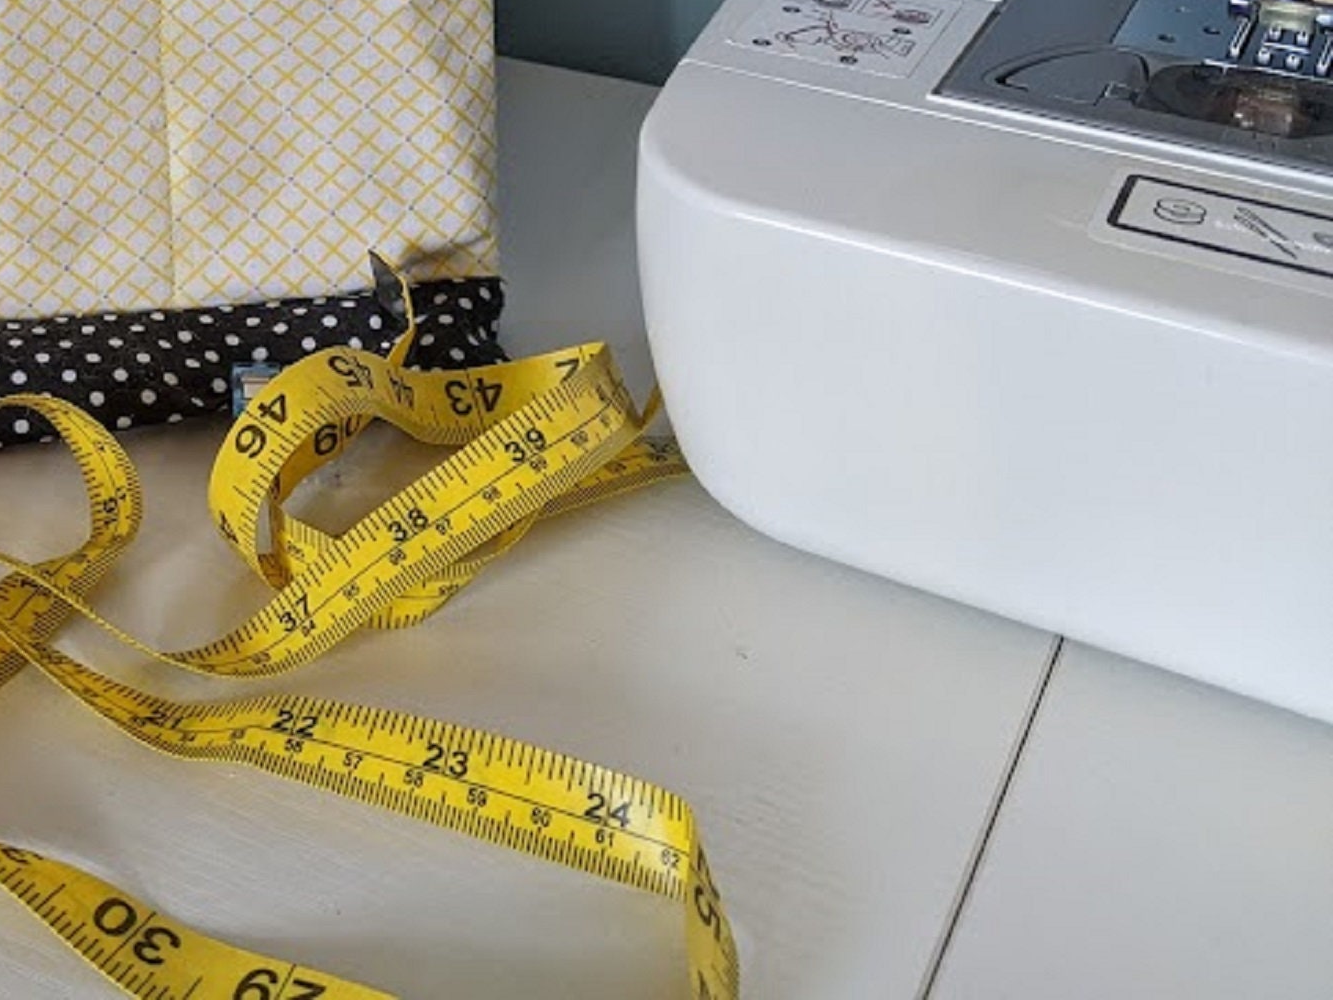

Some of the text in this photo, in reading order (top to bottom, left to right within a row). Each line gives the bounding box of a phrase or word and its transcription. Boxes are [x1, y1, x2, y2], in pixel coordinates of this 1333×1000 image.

[444, 377, 502, 417] 43
[279, 427, 547, 633] 37 38 39
[271, 710, 318, 739] 22
[423, 743, 468, 779] 23
[584, 793, 631, 829] 24
